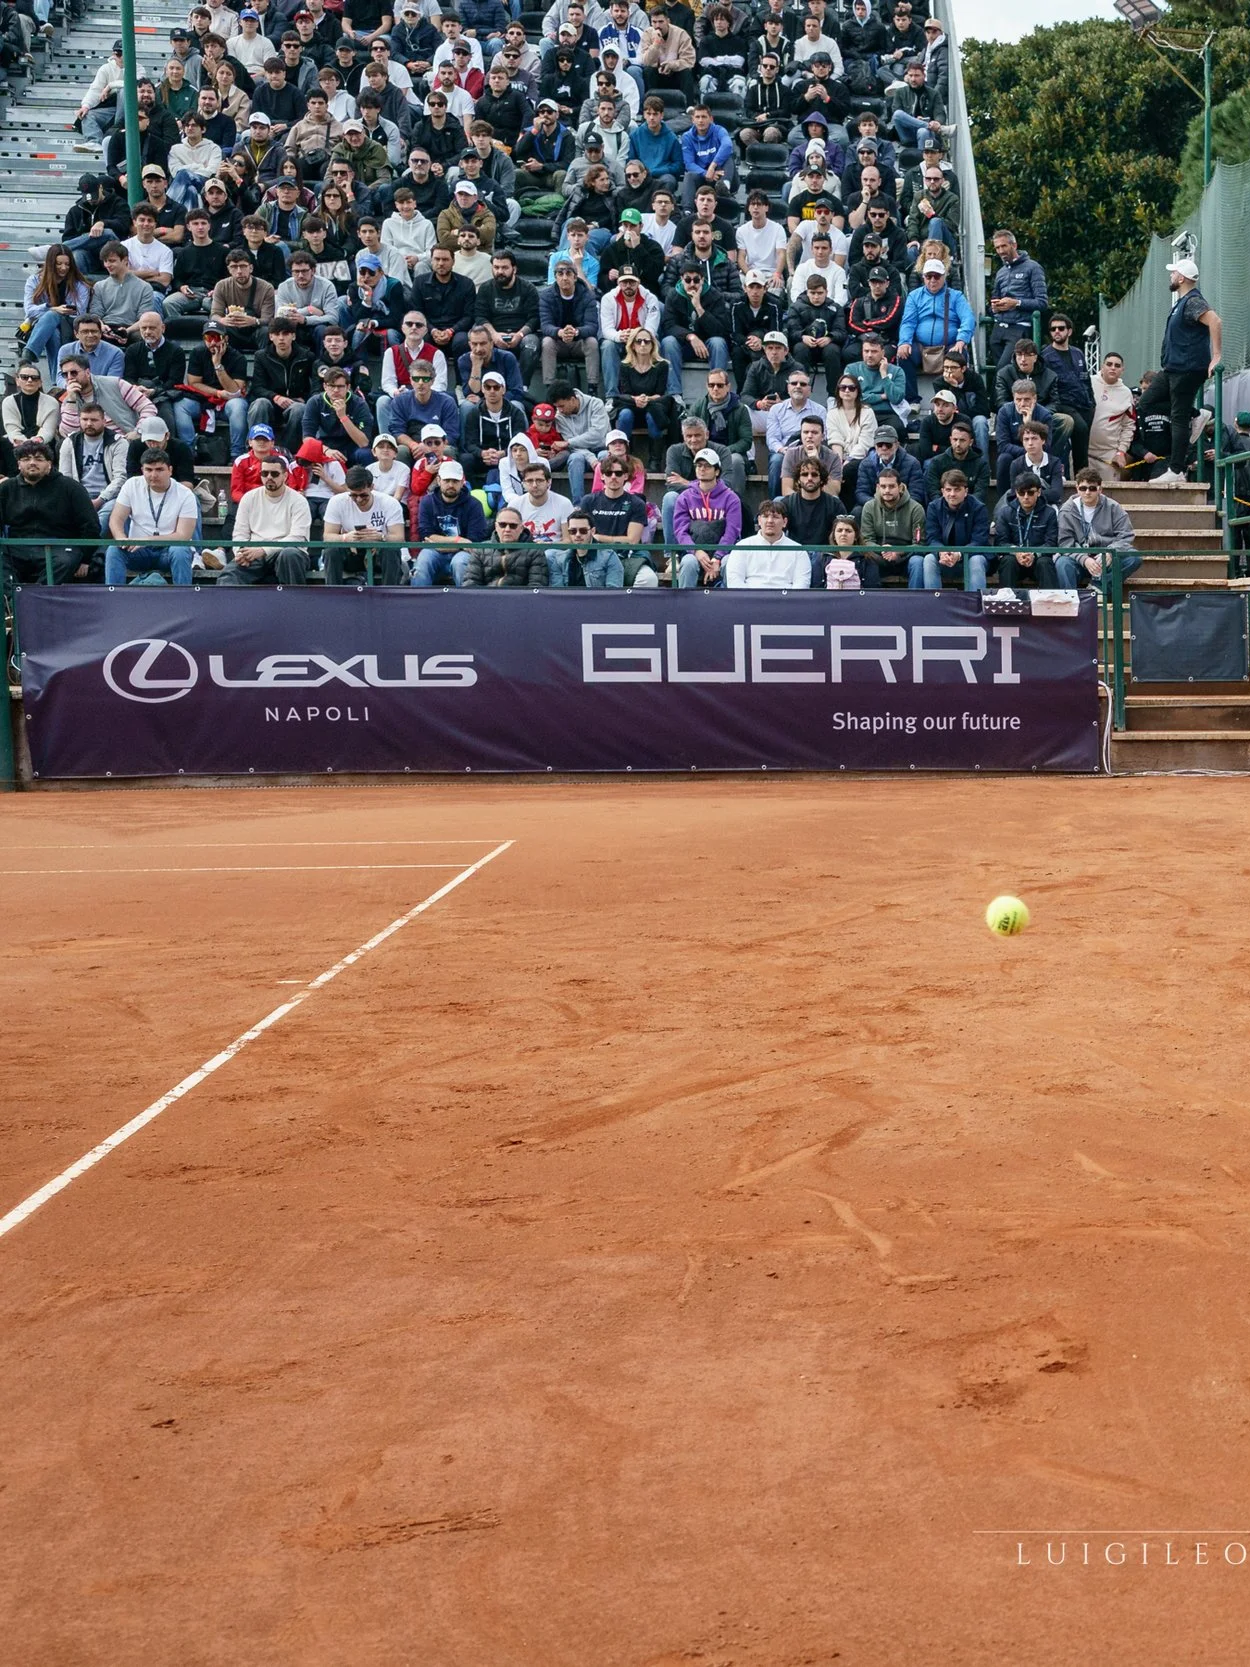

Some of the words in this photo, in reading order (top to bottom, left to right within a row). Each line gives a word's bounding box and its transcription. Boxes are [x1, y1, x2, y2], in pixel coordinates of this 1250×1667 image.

[371, 511, 384, 520] ALL
[581, 623, 1021, 684] GUERRI
[208, 654, 478, 688] LEXUS
[265, 706, 371, 722] NAPOLI
[832, 711, 917, 733] Shaping
[923, 715, 956, 731] our
[961, 711, 1021, 731] future
